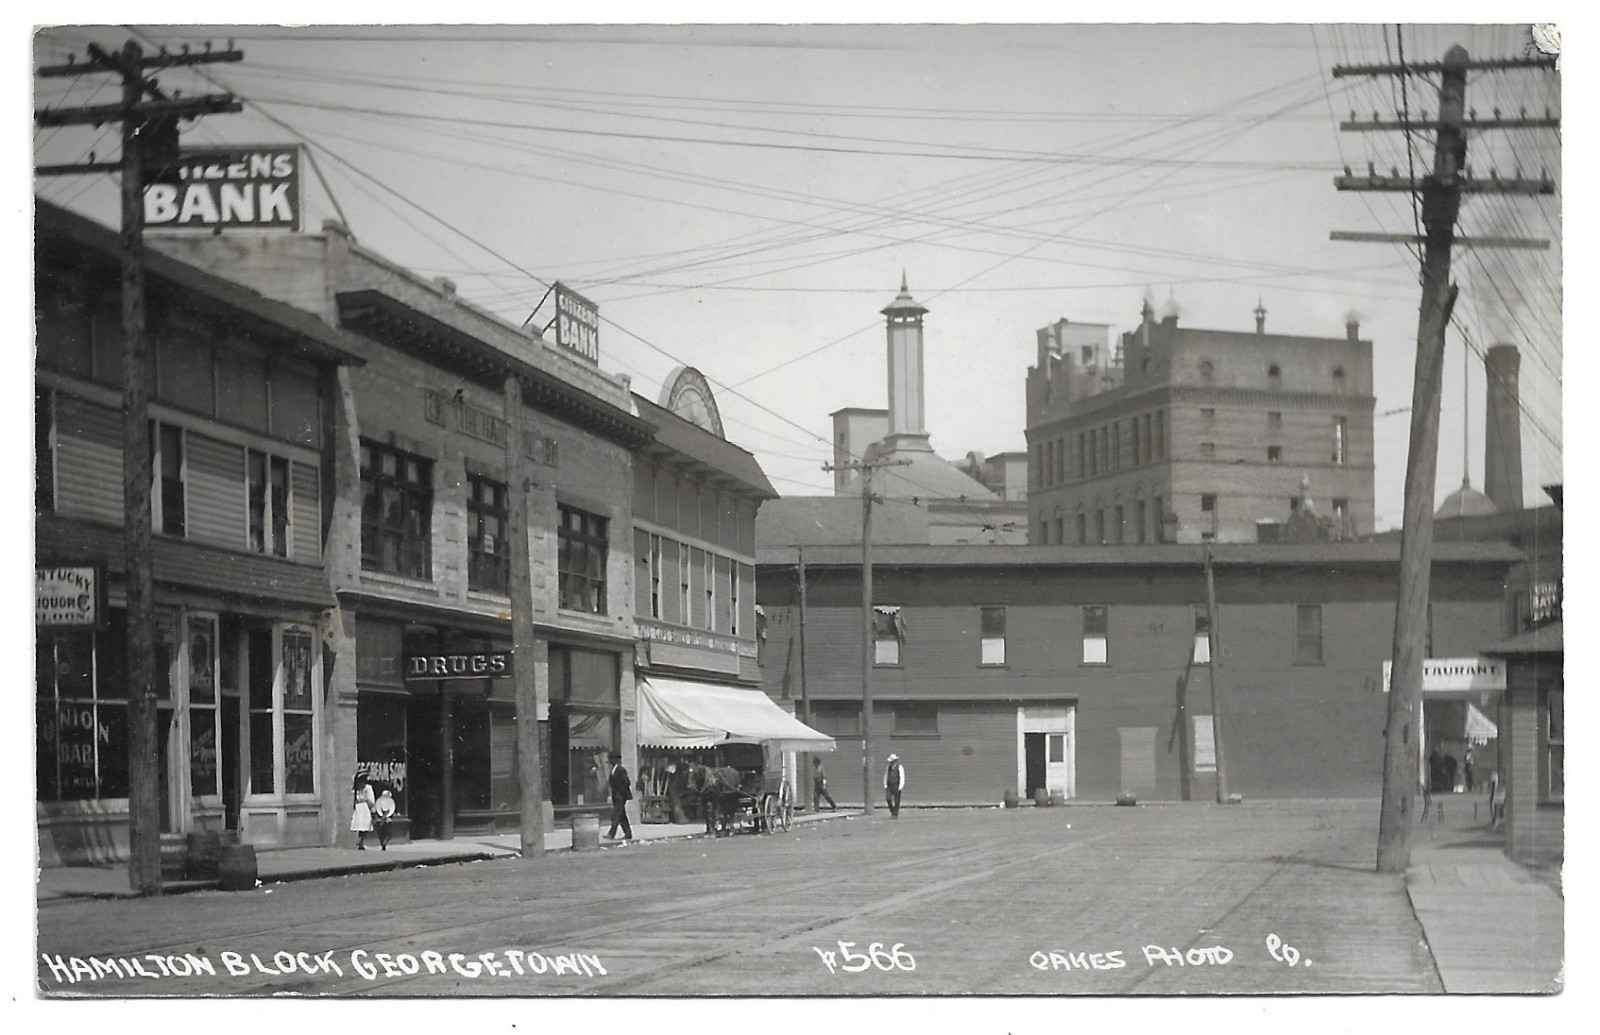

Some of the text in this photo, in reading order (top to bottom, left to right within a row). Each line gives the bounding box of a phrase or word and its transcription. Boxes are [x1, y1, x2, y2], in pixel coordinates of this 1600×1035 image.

[142, 183, 294, 224] BANK
[558, 294, 598, 329] CITIZENS
[560, 314, 598, 361] BANK
[411, 654, 506, 675] DRUGS
[43, 709, 109, 744] UNION
[60, 743, 94, 764] BAR
